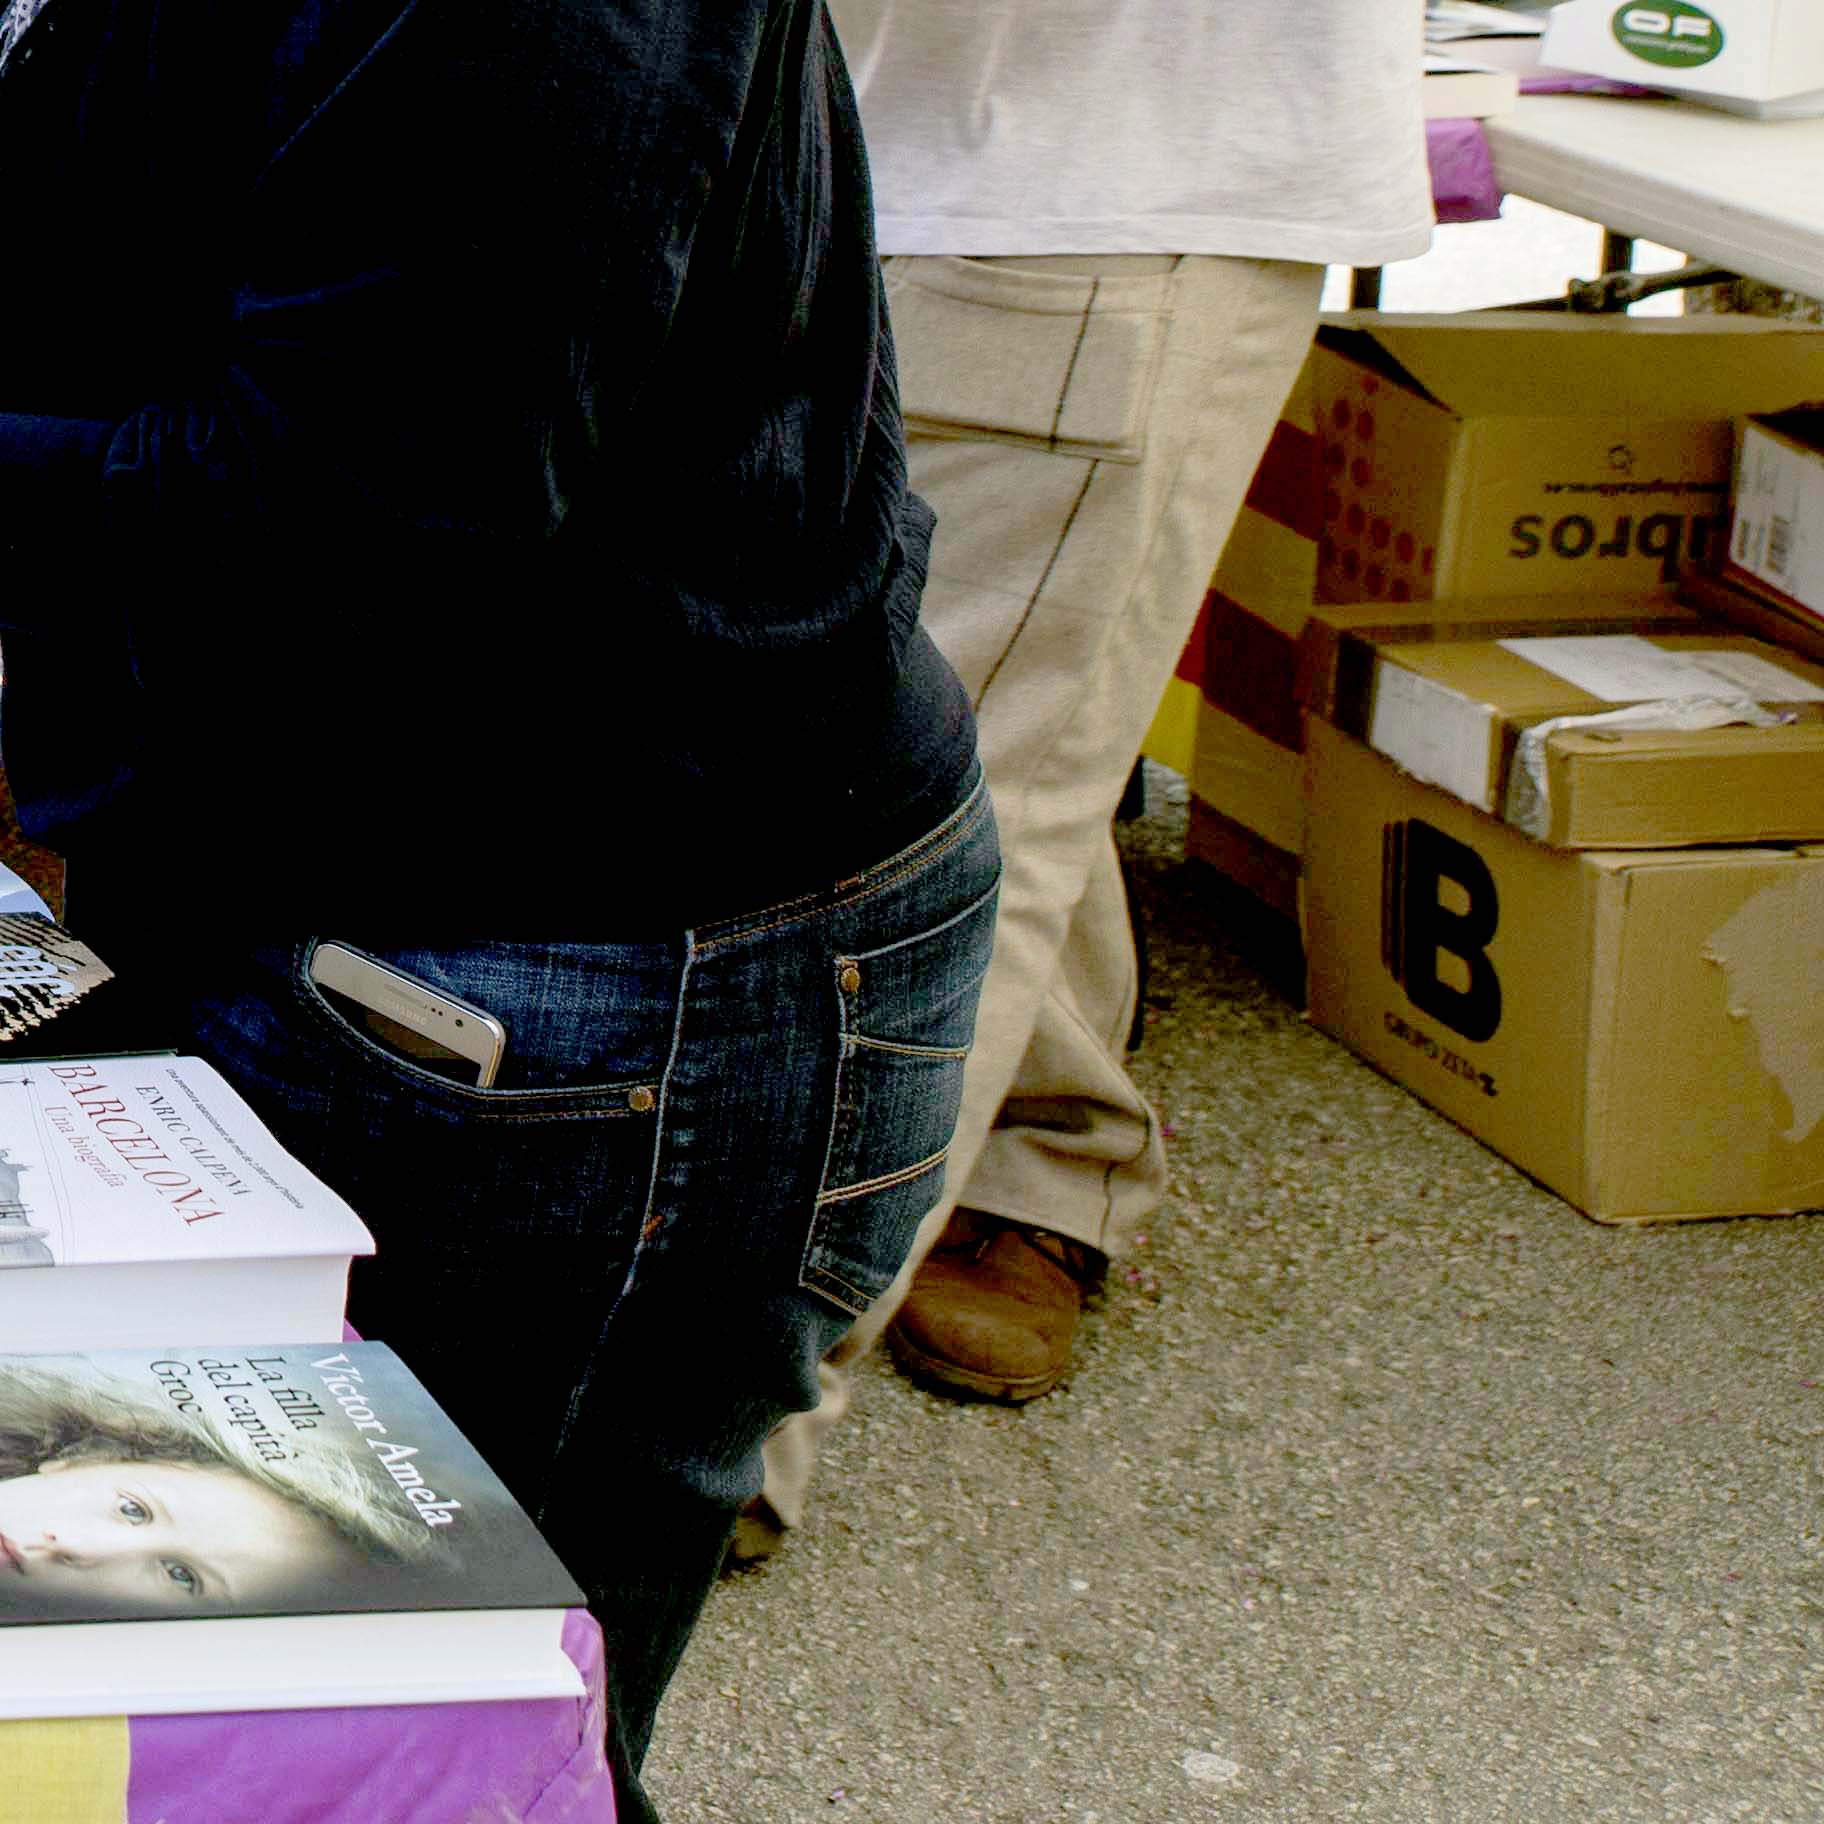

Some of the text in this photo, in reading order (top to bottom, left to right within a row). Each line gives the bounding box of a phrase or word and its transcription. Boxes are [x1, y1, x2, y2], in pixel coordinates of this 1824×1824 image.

[1623, 8, 1712, 37] OF
[1382, 817, 1501, 1042] B
[41, 1106, 127, 1188] Una biografia
[47, 1064, 225, 1225] BARCELONA
[134, 1086, 252, 1196] ENRIC CALPENA
[146, 1360, 203, 1414] Groc
[193, 1358, 299, 1462] del capità
[242, 1356, 326, 1431] La filla
[305, 1353, 462, 1527] Víctor Amela
